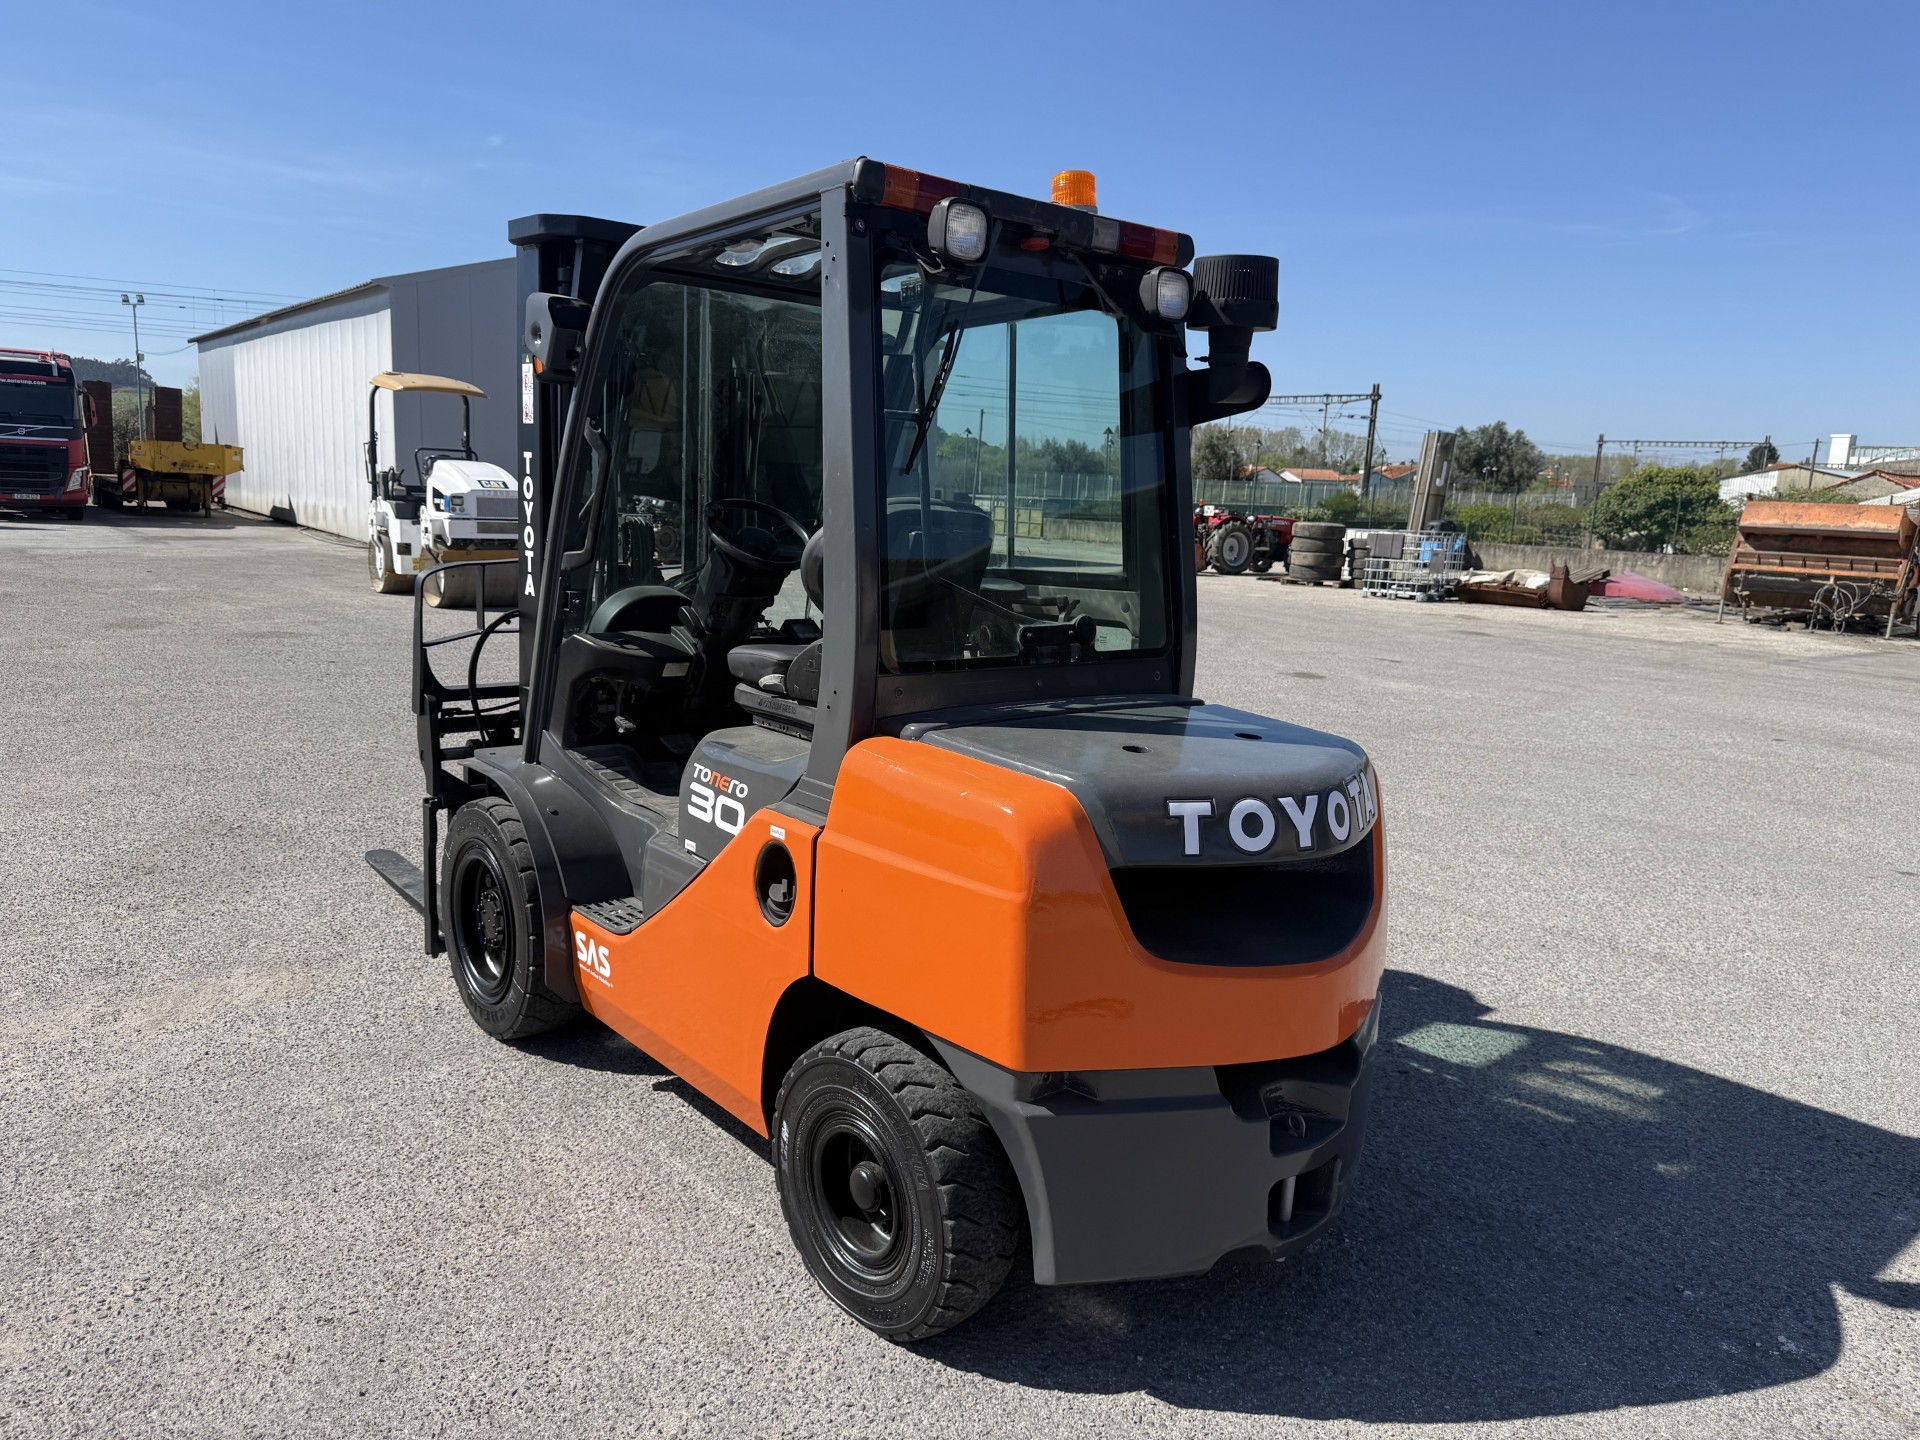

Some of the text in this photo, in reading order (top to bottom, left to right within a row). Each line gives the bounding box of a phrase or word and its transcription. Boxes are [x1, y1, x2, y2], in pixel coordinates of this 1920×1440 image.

[523, 451, 536, 597] TOYOTA
[693, 762, 749, 798] TONERO
[687, 781, 746, 836] 30
[1168, 770, 1376, 855] TOYOTA
[575, 930, 611, 978] SAS
